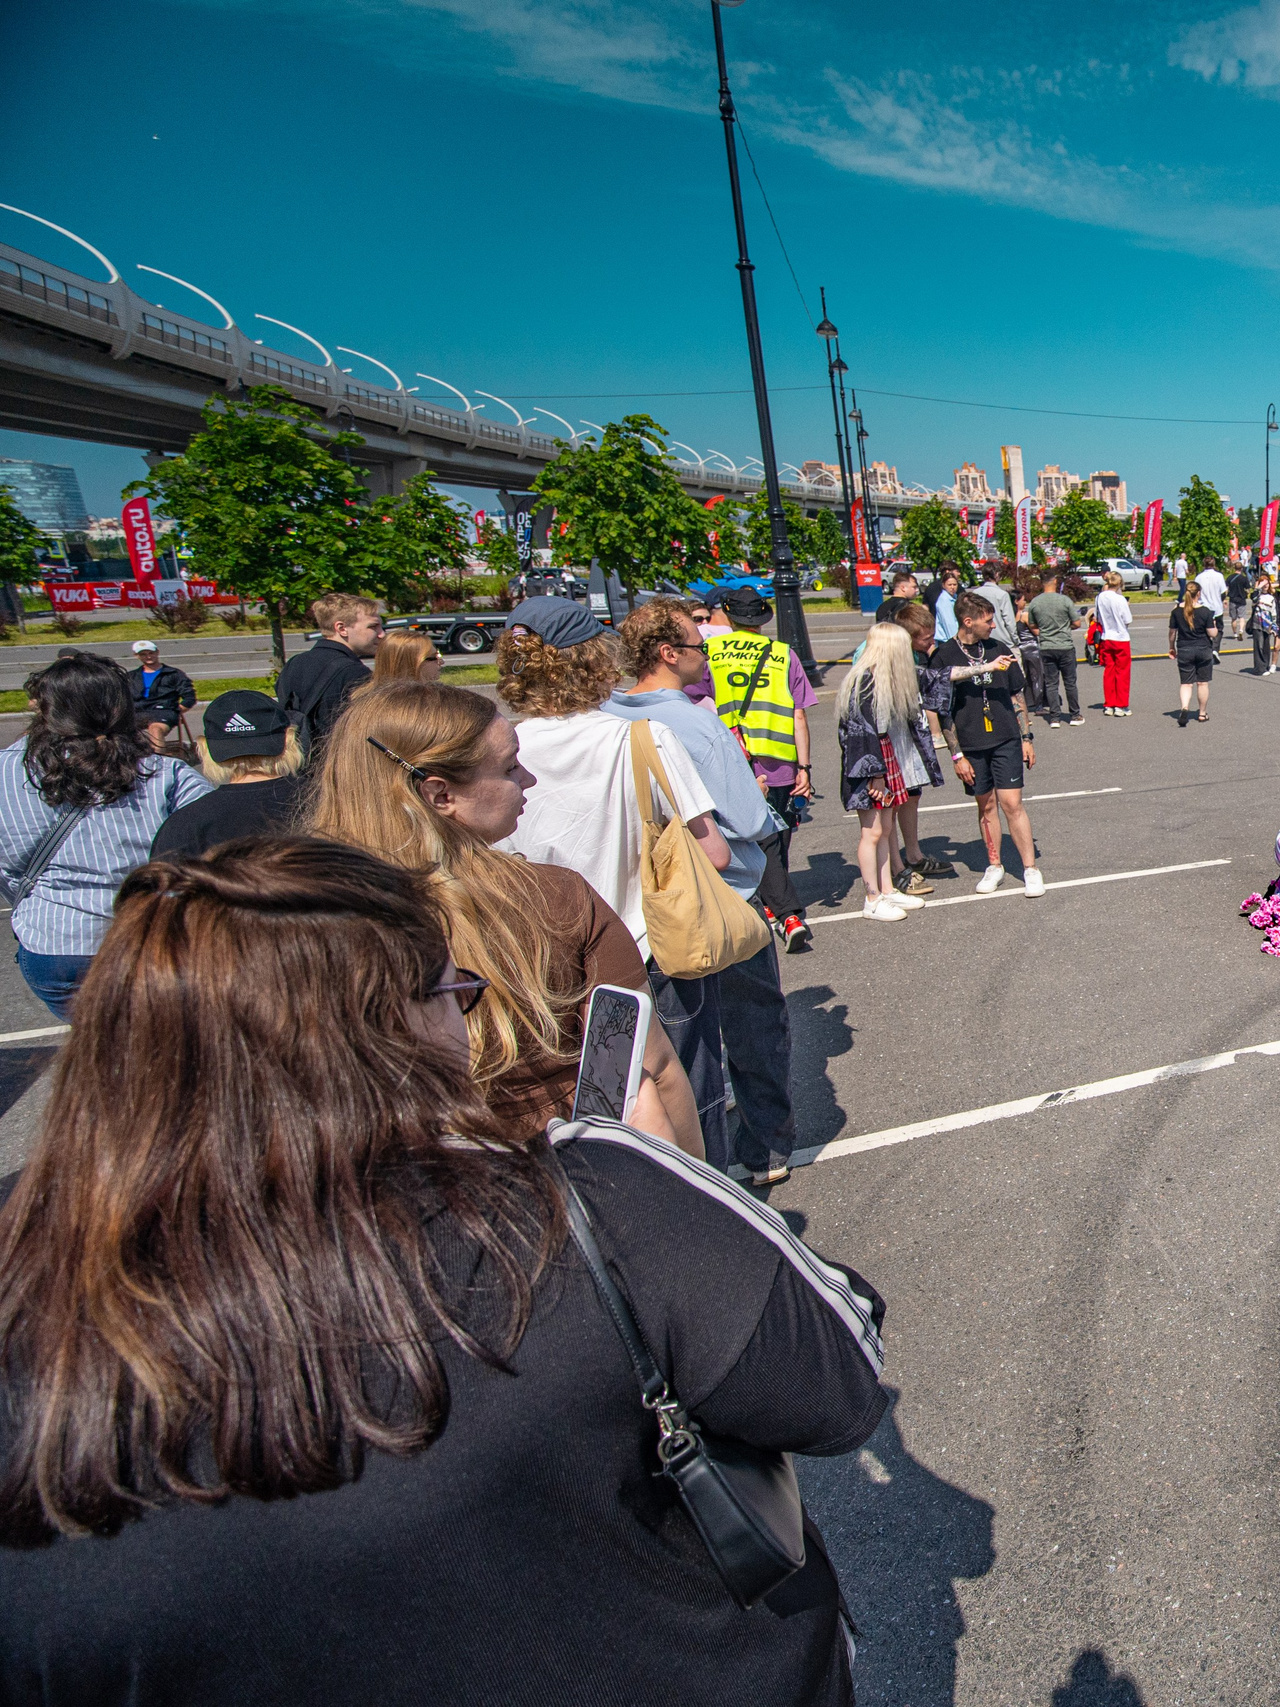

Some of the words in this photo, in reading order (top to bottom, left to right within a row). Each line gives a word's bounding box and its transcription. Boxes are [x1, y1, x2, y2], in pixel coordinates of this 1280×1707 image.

[129, 508, 154, 573] auto.ru
[1264, 507, 1273, 547] ШИНСЕРВИС
[53, 588, 90, 603] YUKA
[224, 724, 256, 732] adidas
